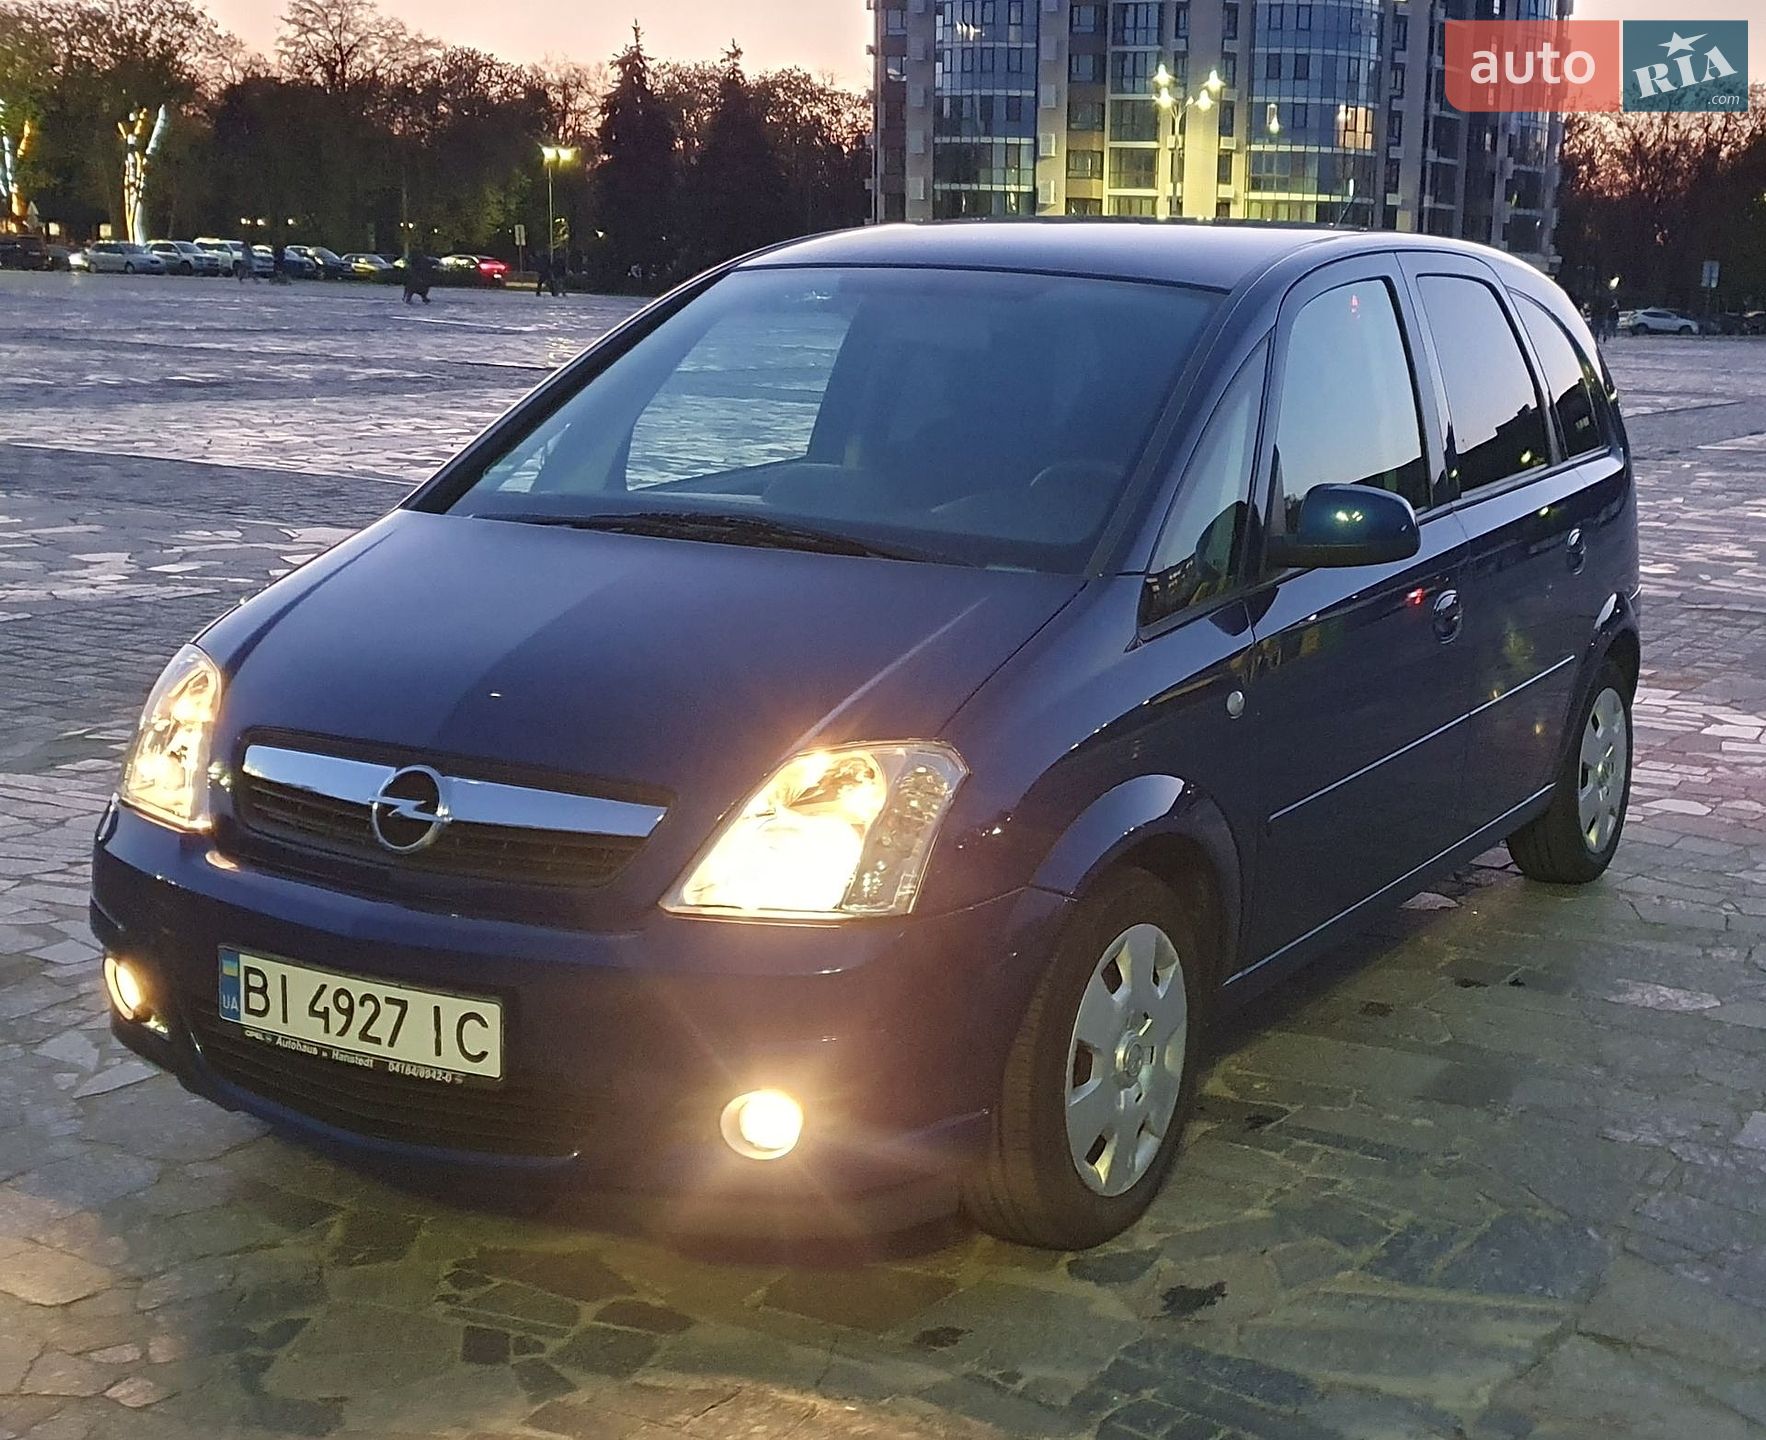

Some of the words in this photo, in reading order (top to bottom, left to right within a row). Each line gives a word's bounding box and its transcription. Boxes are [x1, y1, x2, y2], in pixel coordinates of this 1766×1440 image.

[222, 994, 240, 1012] UA
[244, 965, 289, 1024] BI
[308, 983, 409, 1048] 4927
[432, 1005, 489, 1064] IC
[275, 1036, 319, 1056] Autohaus
[331, 1049, 374, 1069] Hanstedt
